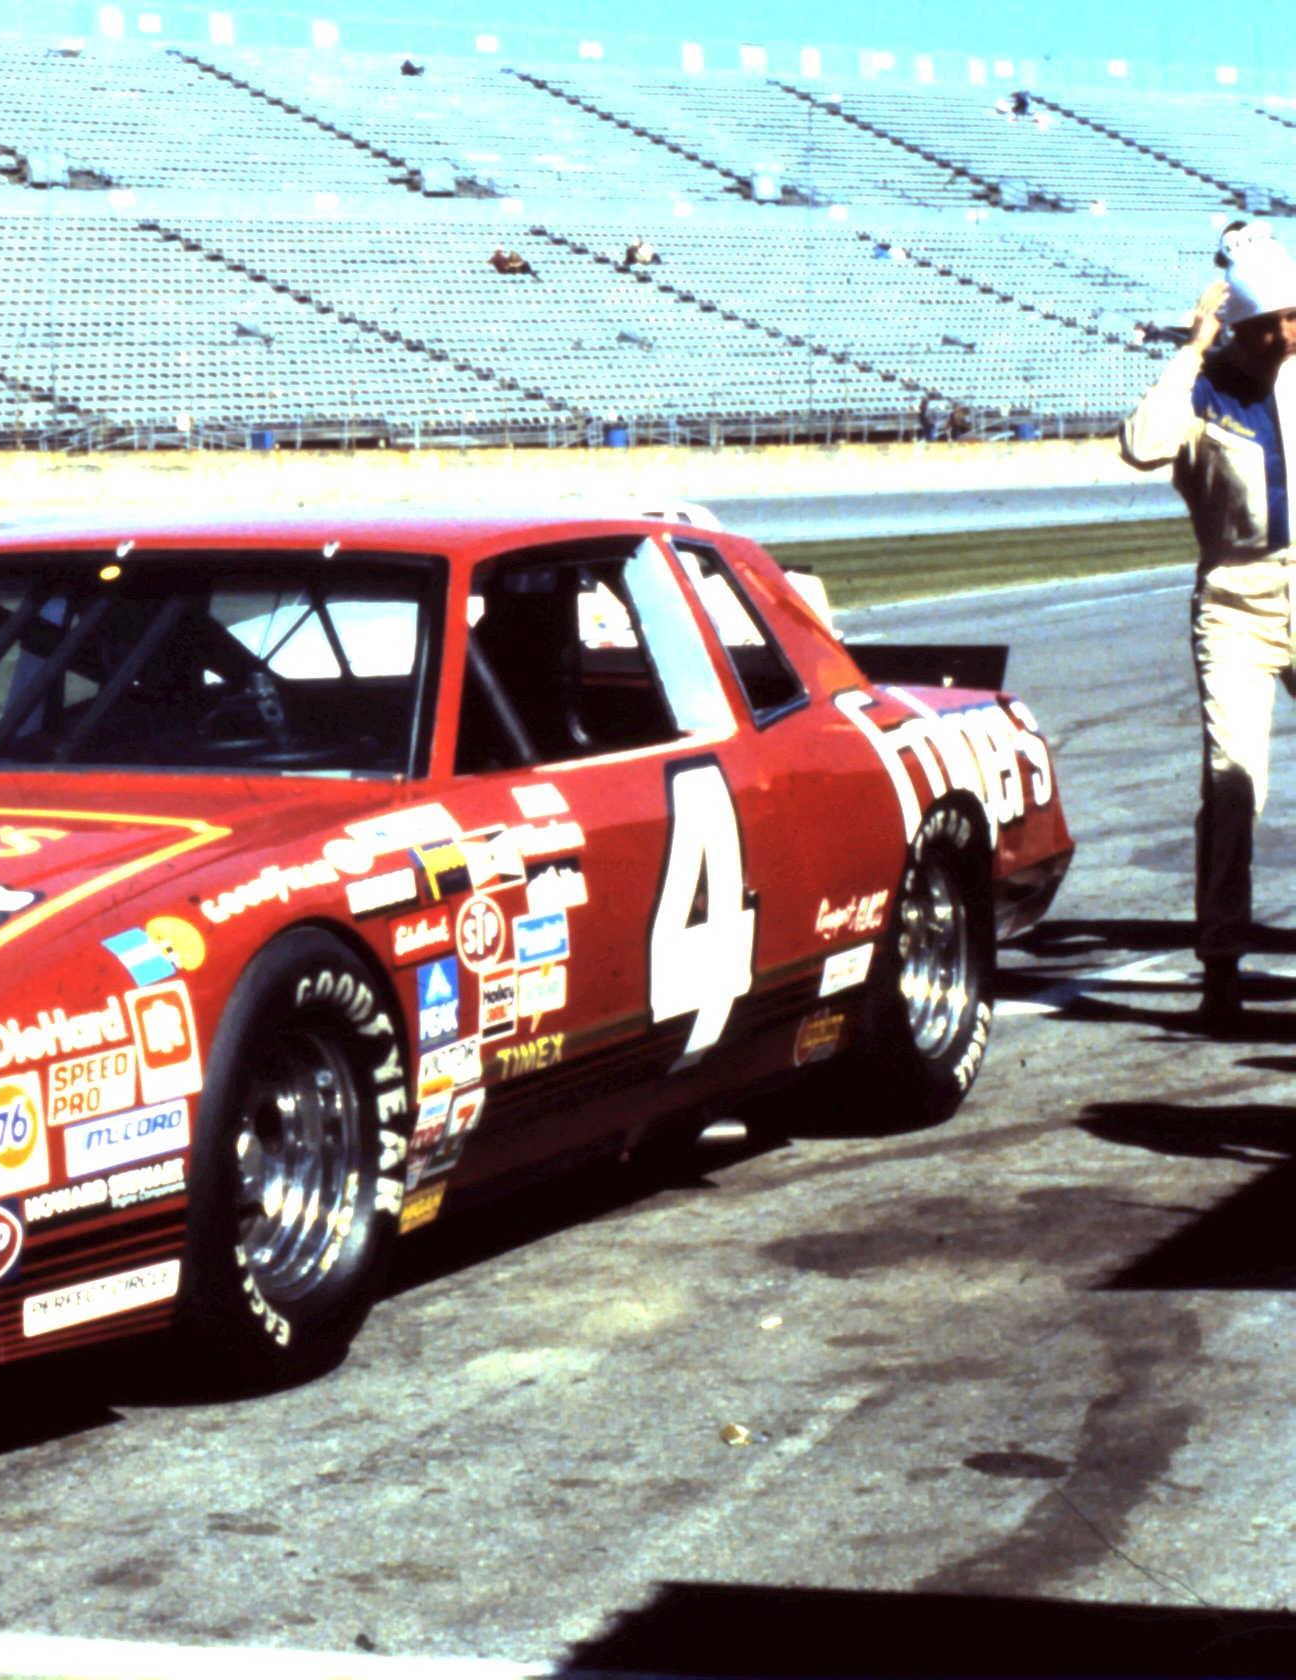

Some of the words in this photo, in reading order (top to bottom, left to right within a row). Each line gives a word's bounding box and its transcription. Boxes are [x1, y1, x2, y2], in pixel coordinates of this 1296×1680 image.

[462, 901, 499, 956] STP
[649, 762, 756, 1056] 4
[53, 1052, 128, 1092] SPEED
[496, 1032, 565, 1080] TIMEX
[53, 1087, 101, 1121] PRO
